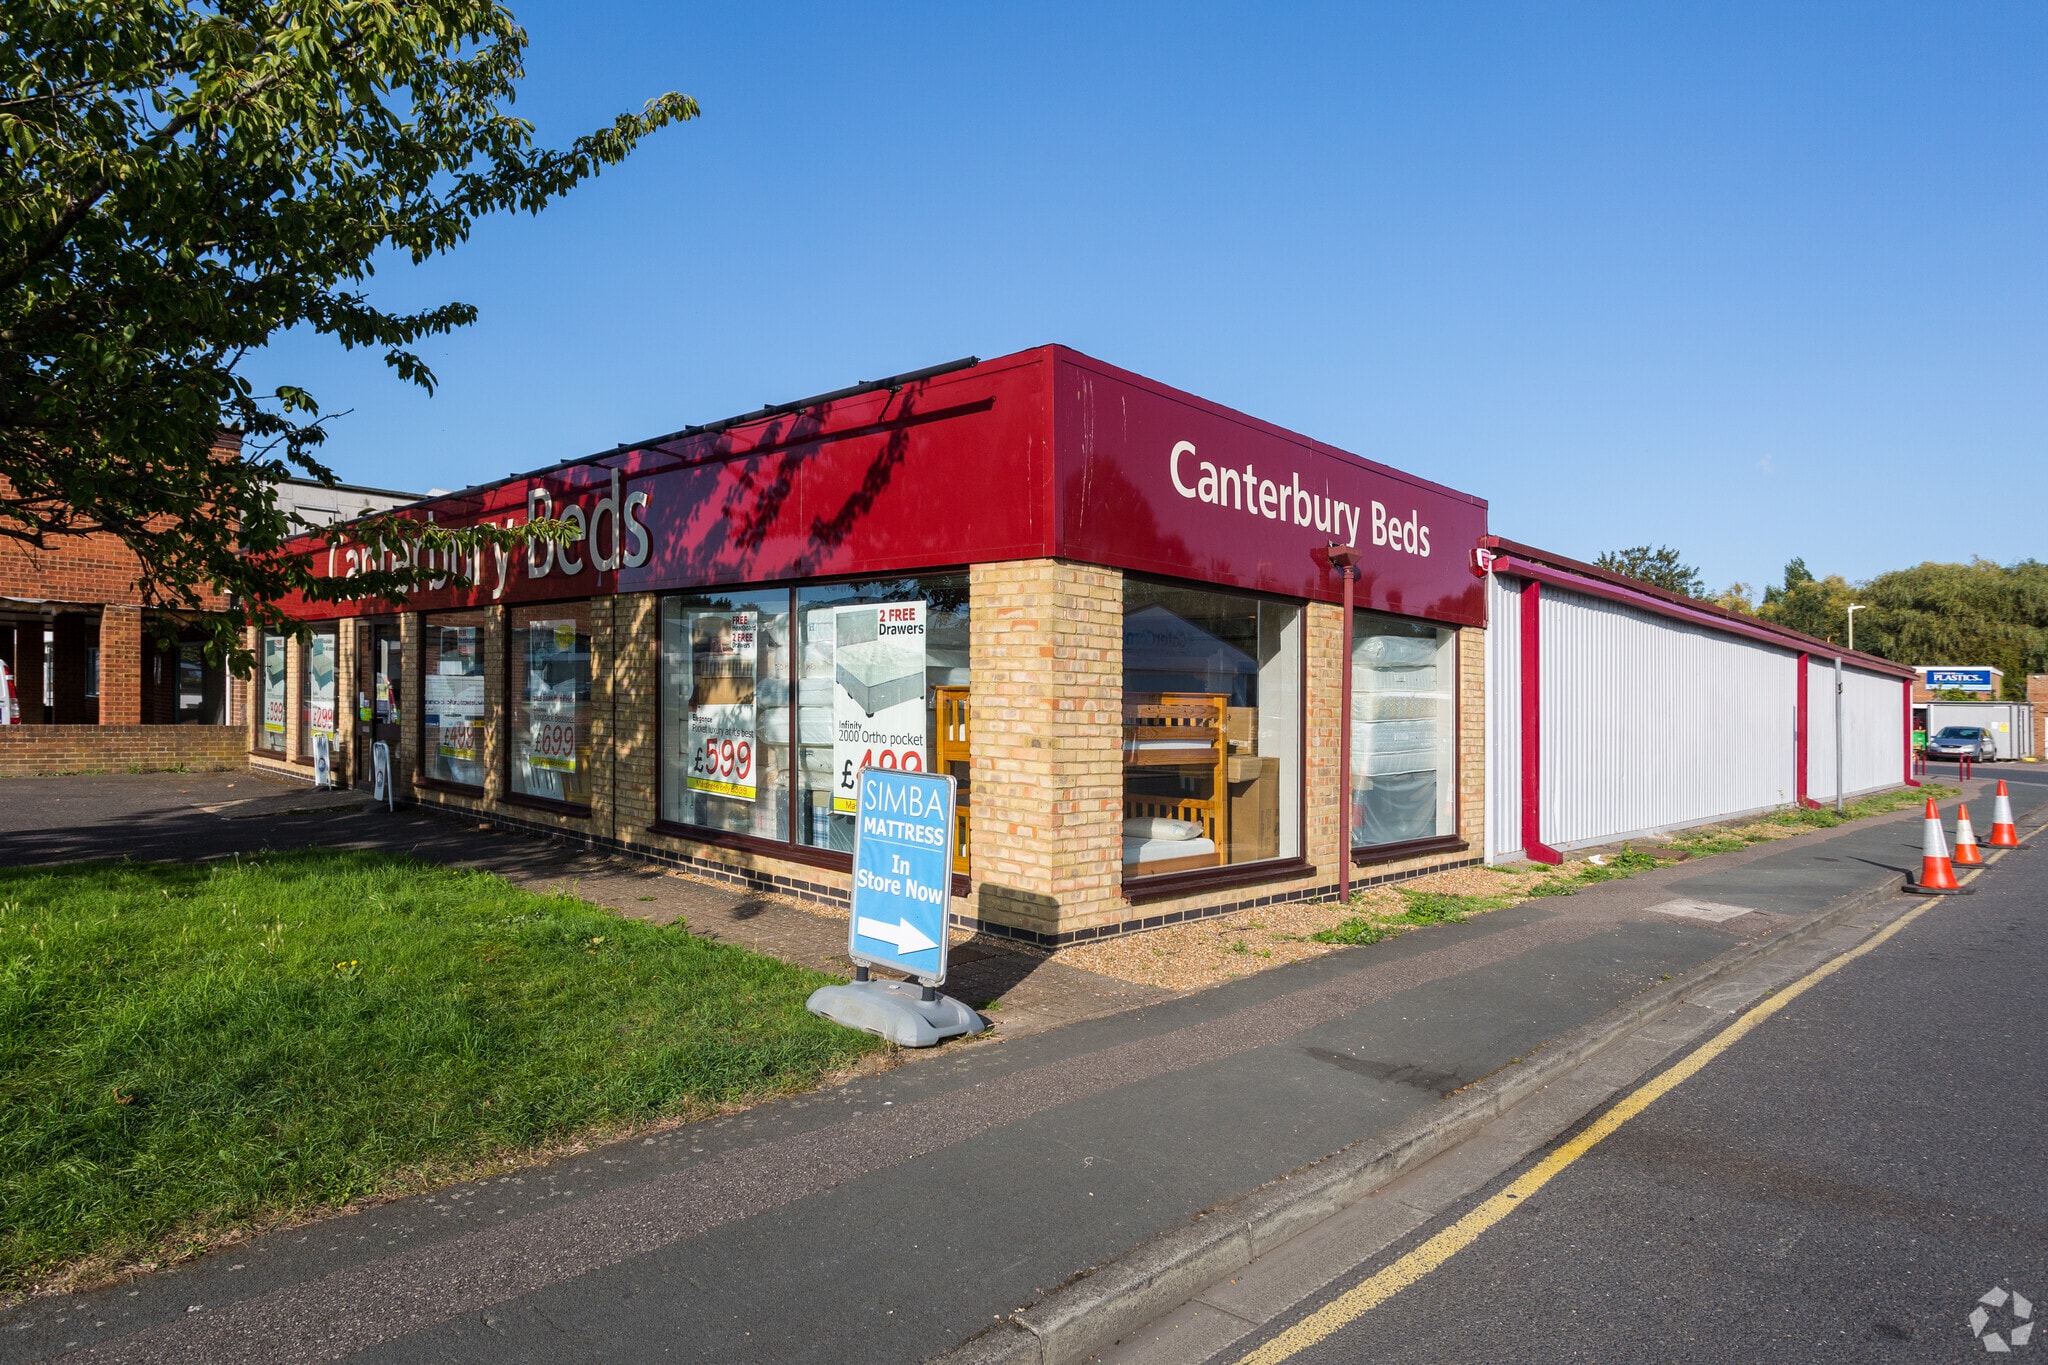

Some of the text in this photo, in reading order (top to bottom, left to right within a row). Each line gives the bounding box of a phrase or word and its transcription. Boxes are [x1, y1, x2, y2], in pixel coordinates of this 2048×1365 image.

[1170, 440, 1430, 557] Canterbury Beds
[528, 468, 648, 579] Beds
[732, 616, 748, 625] FREE
[879, 608, 915, 622] 2 FREE
[737, 633, 753, 642] FREE
[879, 623, 924, 636] Drawers
[838, 720, 862, 731] Infinity
[838, 729, 923, 747] 2000 Ortho pocket
[534, 725, 574, 757] £699
[694, 738, 751, 780] £599
[864, 780, 944, 820] SIMBA
[864, 816, 944, 847] MATTRESS
[891, 855, 910, 876] In
[857, 868, 943, 905] Store Now
